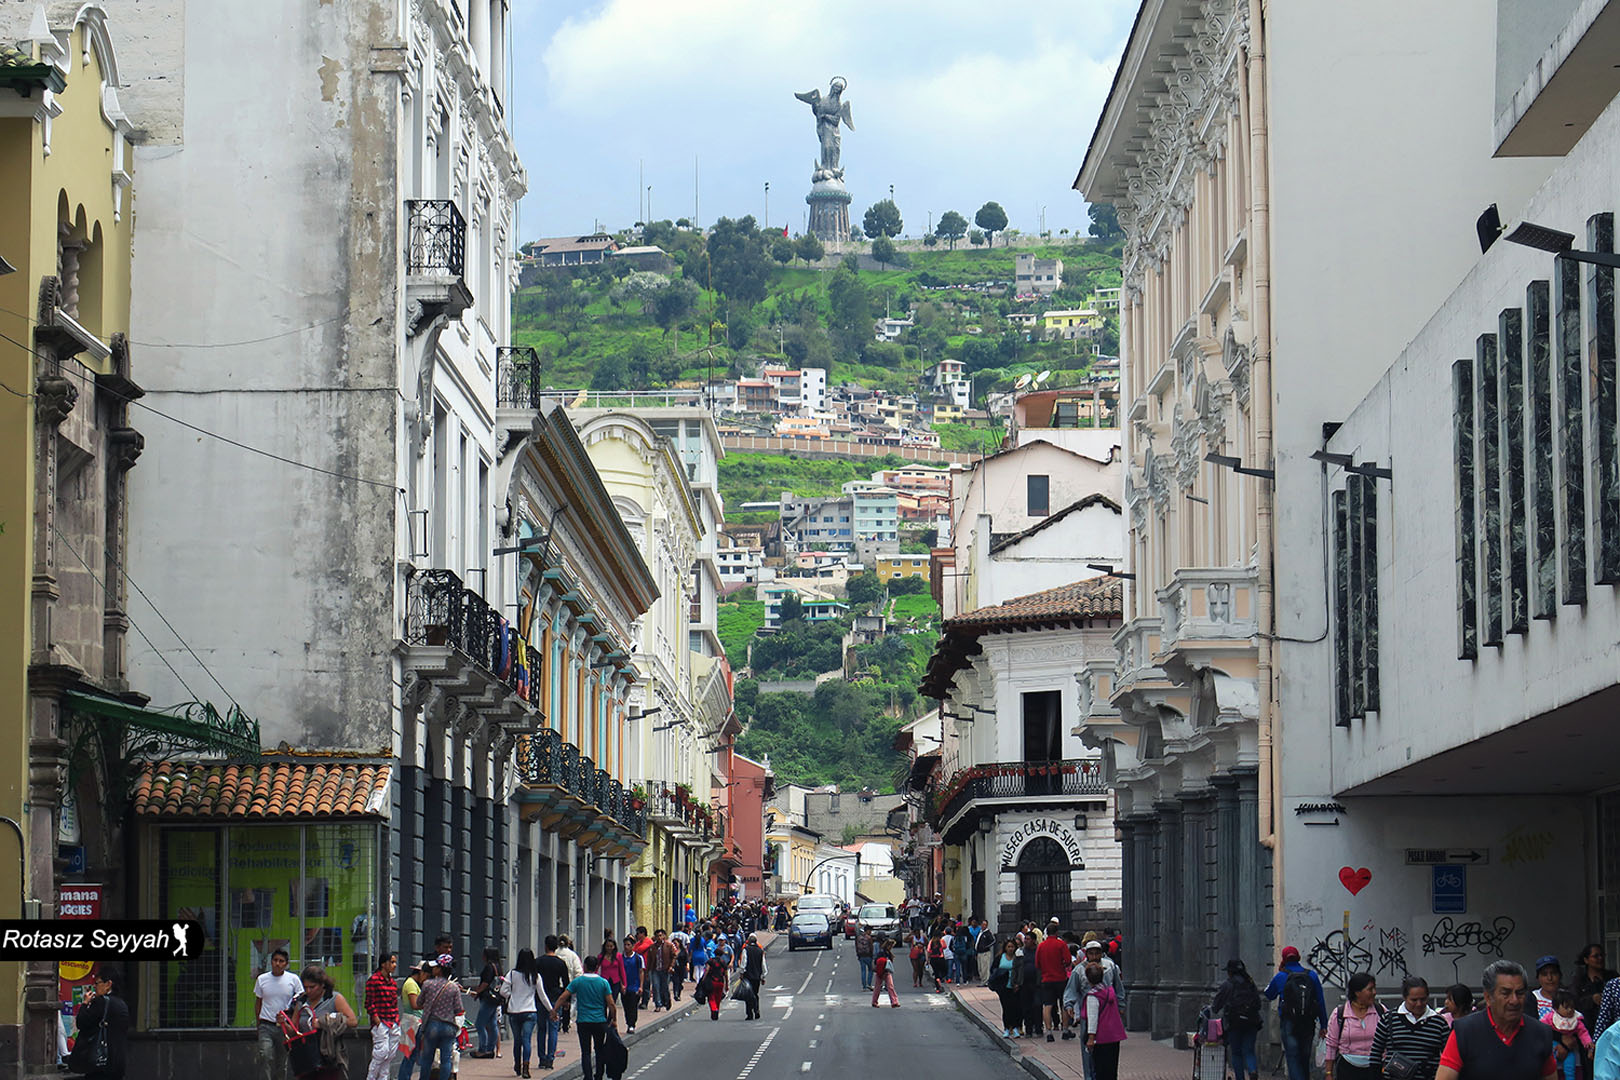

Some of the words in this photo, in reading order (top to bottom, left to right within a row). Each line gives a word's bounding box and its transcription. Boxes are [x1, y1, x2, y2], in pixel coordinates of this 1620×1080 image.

[1003, 831, 1024, 866] MUSEO
[1025, 819, 1047, 836] CASA
[1050, 821, 1062, 836] DE
[1061, 829, 1083, 866] SUCRE
